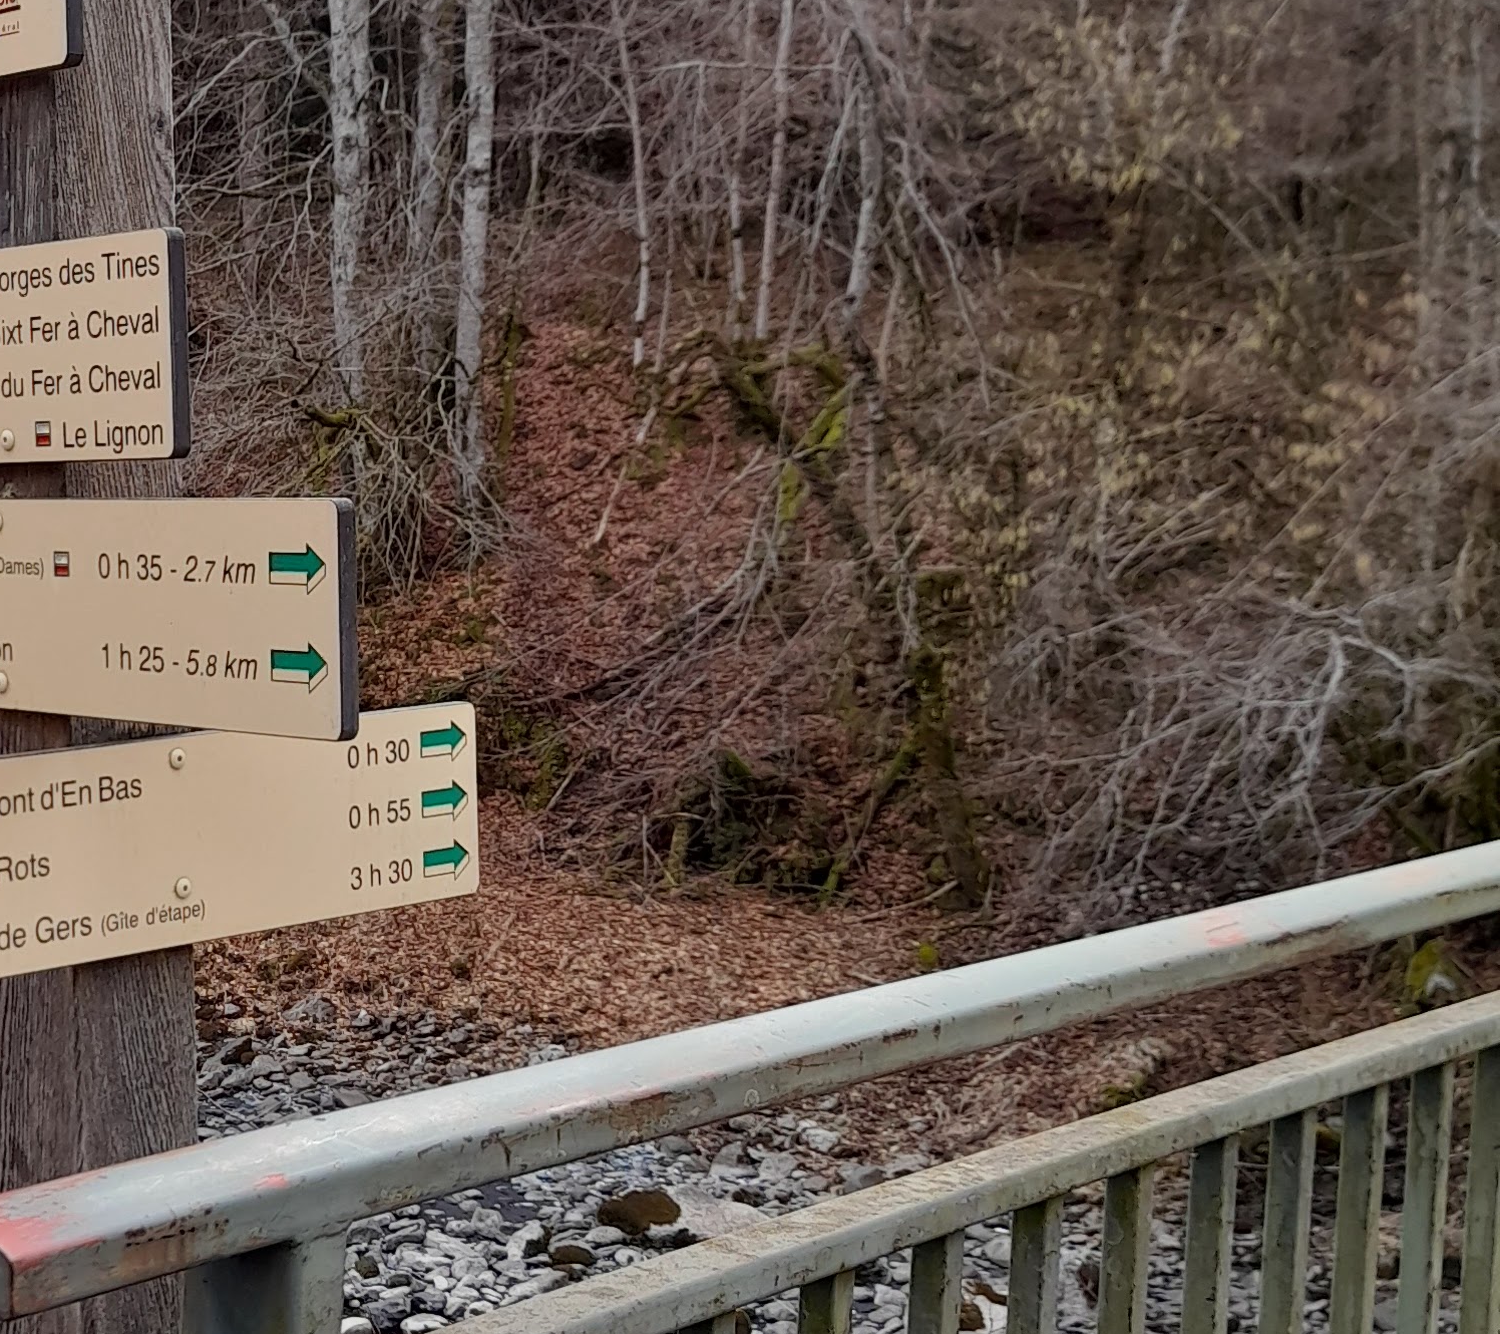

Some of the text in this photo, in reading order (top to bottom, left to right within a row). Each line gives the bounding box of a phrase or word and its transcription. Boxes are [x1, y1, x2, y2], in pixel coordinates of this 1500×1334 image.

[59, 259, 94, 285] des
[101, 253, 159, 280] Tines
[30, 317, 60, 343] Fer
[67, 311, 79, 340] à
[86, 305, 159, 338] Cheval
[1, 372, 24, 398] du
[31, 369, 62, 396] Fer
[69, 365, 81, 394] à
[88, 361, 161, 393] Cheval
[63, 420, 163, 453] Le Lignon
[98, 553, 110, 579] 0
[118, 553, 129, 579] h
[137, 554, 162, 581] 35
[184, 555, 216, 583] 2.7
[222, 555, 255, 584] km
[102, 643, 109, 668] 1
[120, 643, 132, 669] h
[139, 646, 164, 673] 25
[186, 649, 217, 677] 5.8
[224, 651, 257, 680] km
[347, 739, 409, 769] 0 h 30
[40, 780, 92, 810] d'En
[99, 776, 142, 803] Bas
[349, 799, 410, 829] 0 h 55
[351, 859, 412, 890] 3 h 30
[35, 915, 92, 943] Gers
[101, 911, 138, 937] (Gîte
[146, 899, 206, 925] d'étape)
